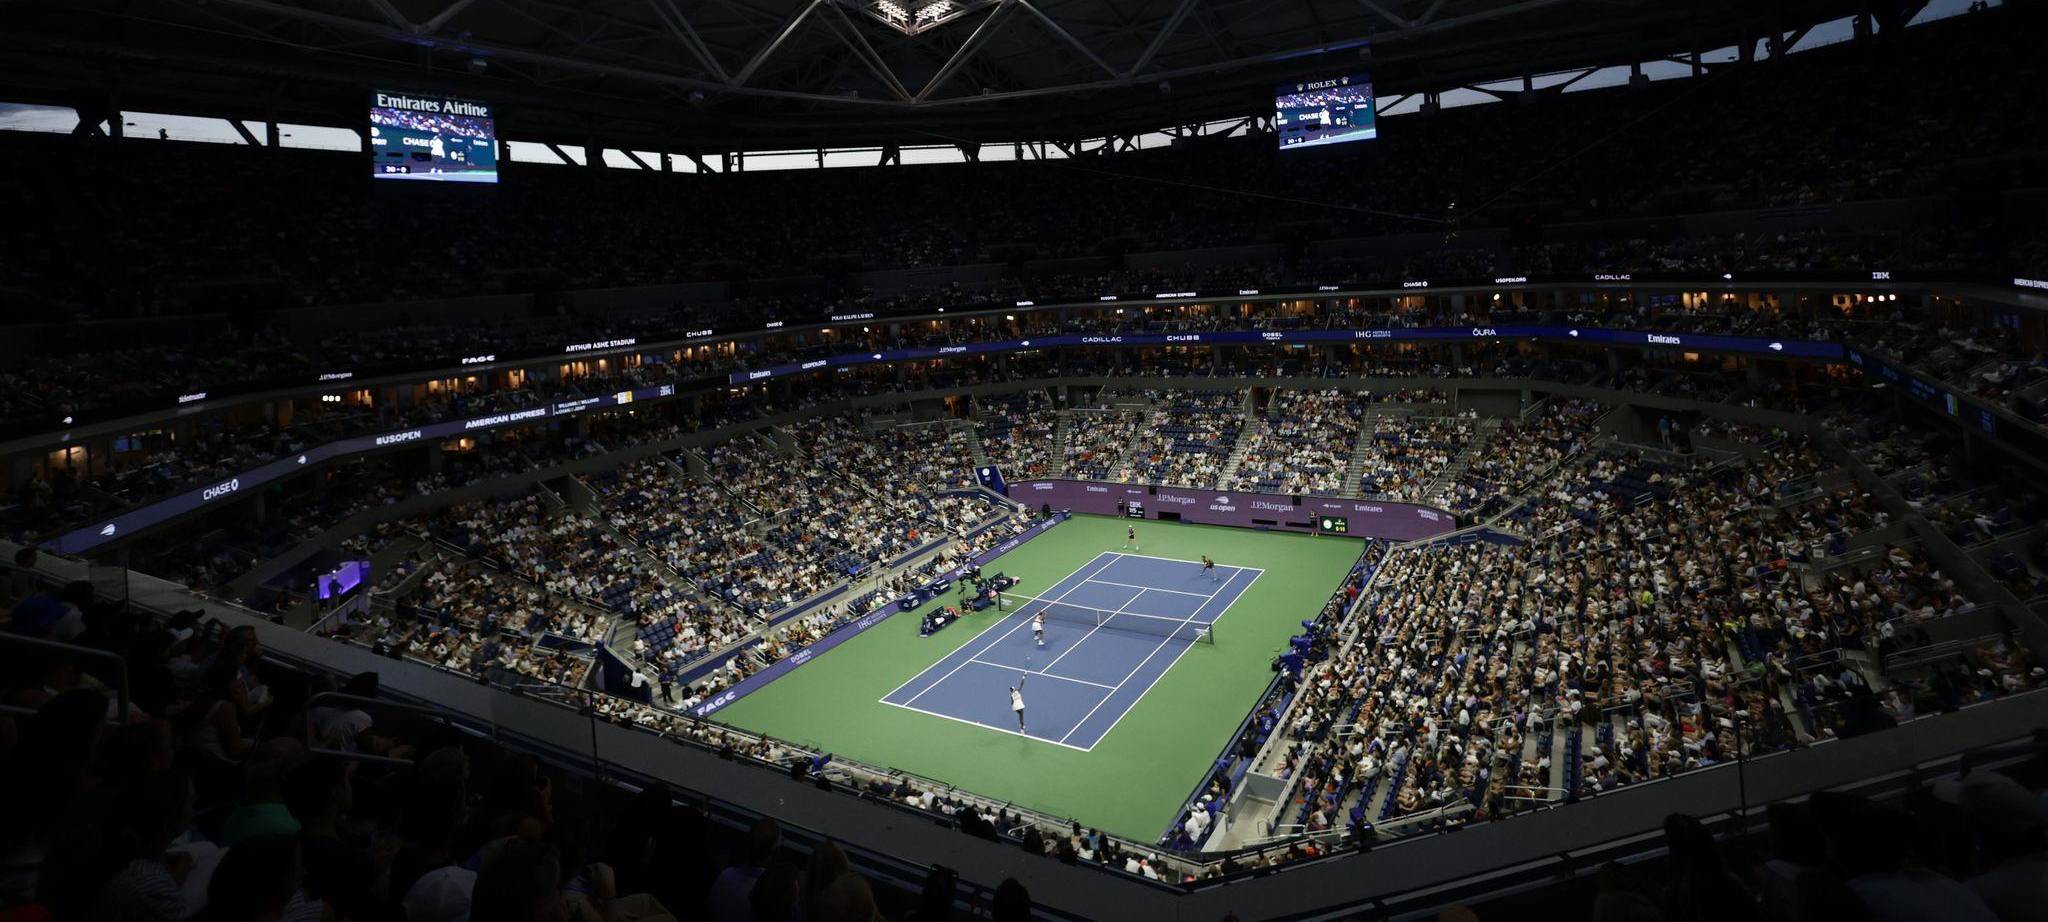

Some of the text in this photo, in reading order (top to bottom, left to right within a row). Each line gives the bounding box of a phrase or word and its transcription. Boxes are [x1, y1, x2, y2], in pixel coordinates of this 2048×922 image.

[1308, 80, 1337, 90] ROLEX
[377, 94, 488, 117] Emirates Airline
[403, 137, 430, 147] CHASE
[686, 329, 713, 337] CHUBB
[1355, 330, 1372, 338] IHG
[566, 338, 636, 352] ARTHUR ASHE STADIUM
[1647, 334, 1681, 345] Emirates
[750, 369, 771, 380] Emirates
[465, 408, 546, 429] AMERICAN EXPRESS
[203, 482, 231, 500] CHASE
[1157, 494, 1196, 505] J.P.Morgan
[1250, 501, 1294, 513] J.P.Morgan
[1354, 504, 1383, 513] Emirates
[857, 616, 873, 630] IHG
[790, 648, 812, 663] DOBEL
